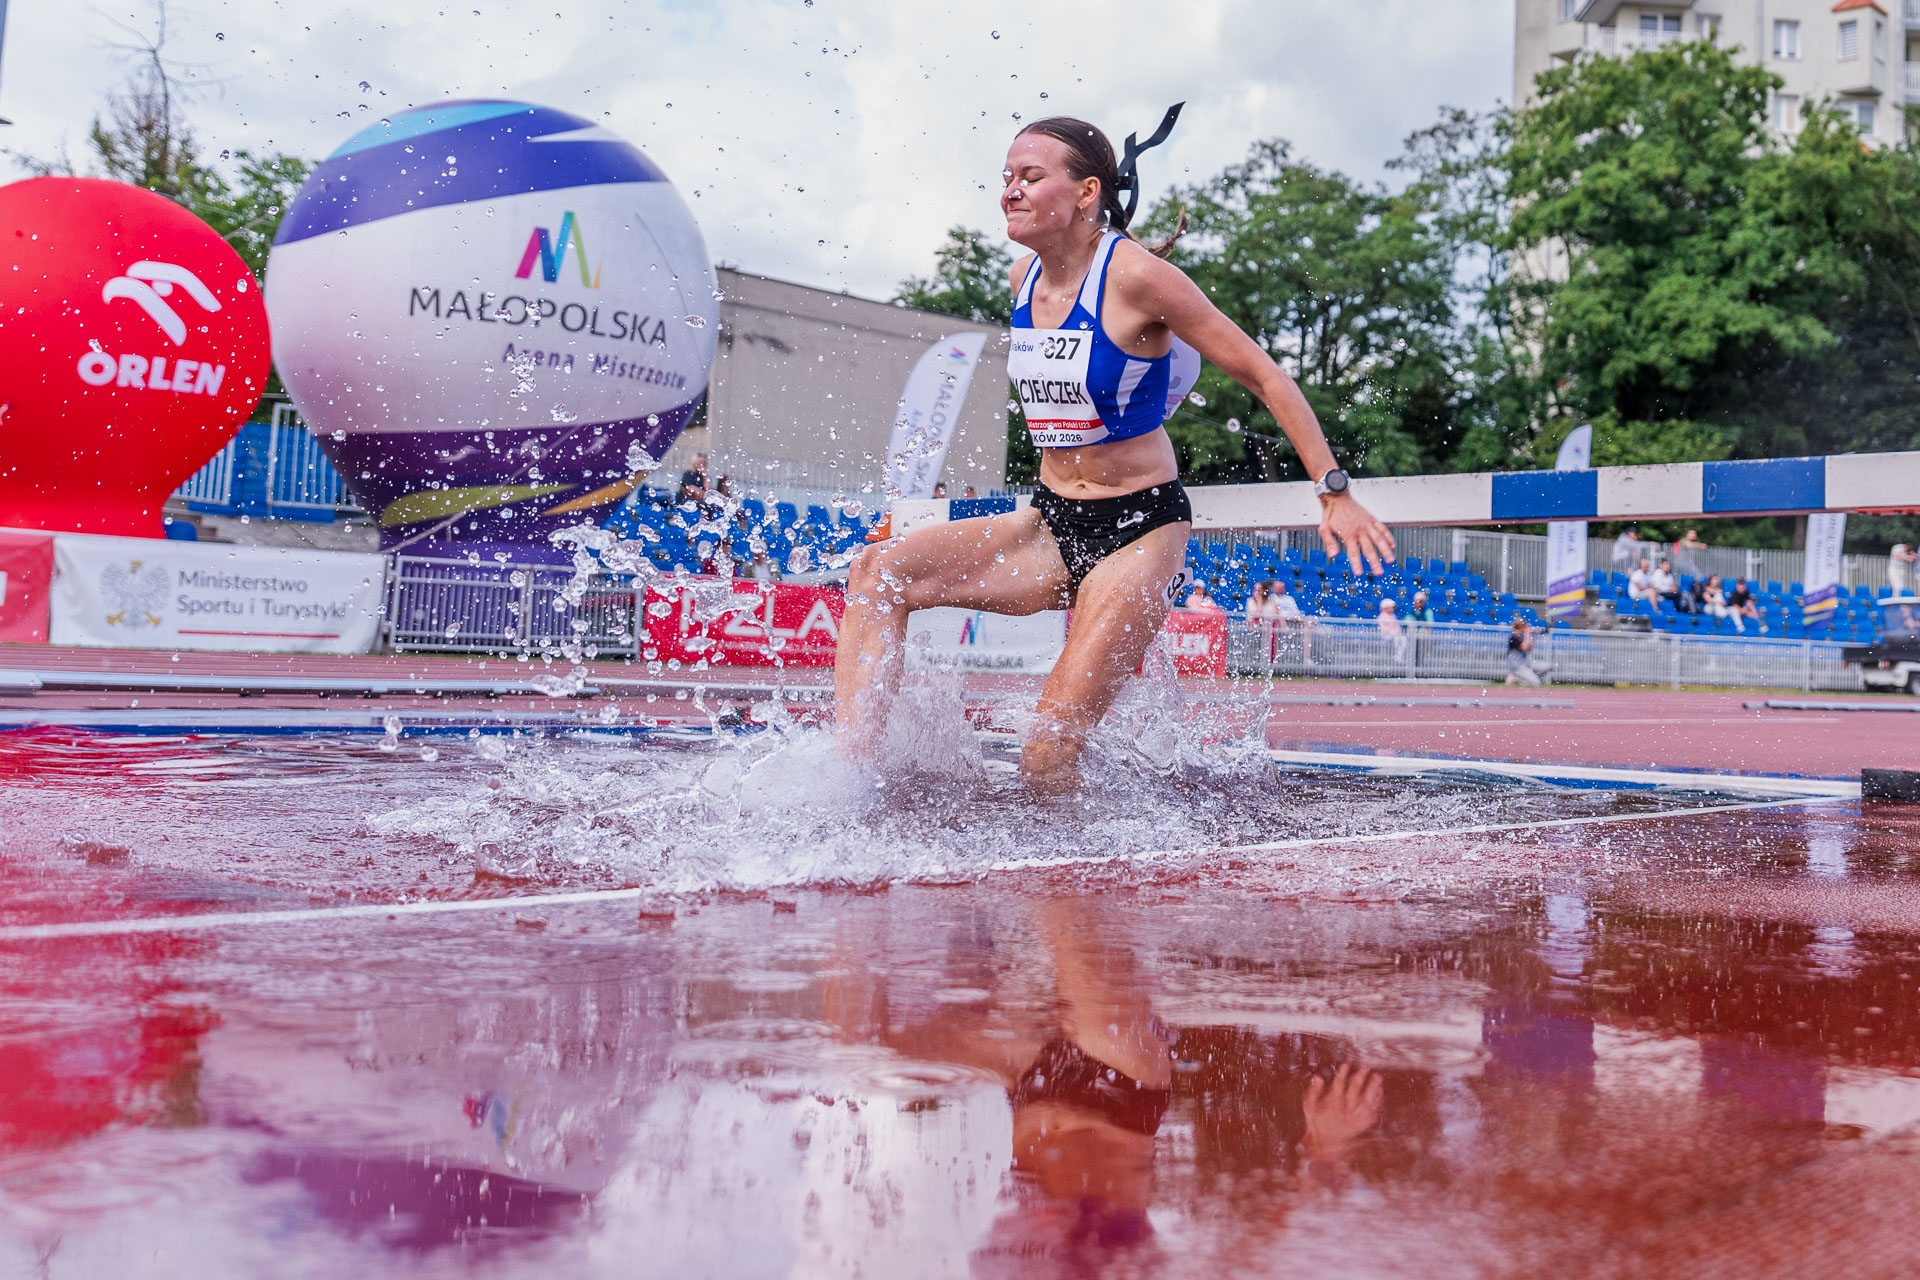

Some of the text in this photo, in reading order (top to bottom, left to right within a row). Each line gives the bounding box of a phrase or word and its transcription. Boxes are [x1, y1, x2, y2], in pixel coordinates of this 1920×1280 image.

[409, 287, 667, 346] MAŁOPOLSKA
[1012, 340, 1034, 352] aków
[77, 351, 226, 396] ORLEN
[503, 342, 687, 389] Aena Mistrzostw
[1015, 377, 1089, 405] CIEJCZEK
[1059, 433, 1083, 443] 2026
[178, 570, 309, 593] Ministerstwo
[176, 594, 346, 620] Sportu i Turystyki
[1168, 633, 1209, 656] LEN
